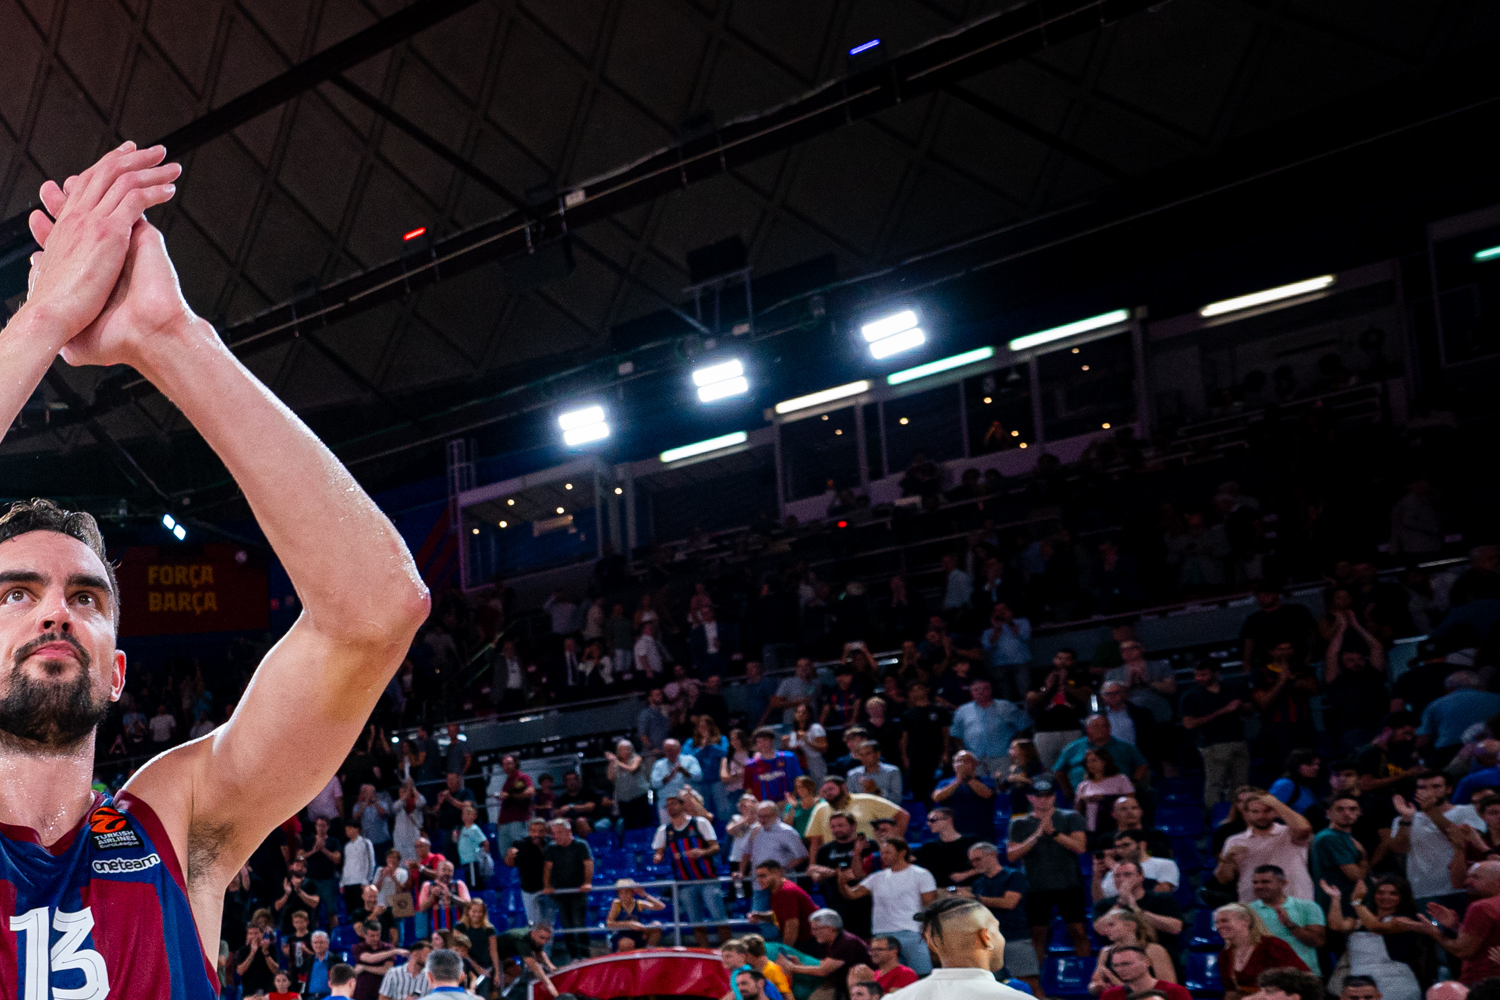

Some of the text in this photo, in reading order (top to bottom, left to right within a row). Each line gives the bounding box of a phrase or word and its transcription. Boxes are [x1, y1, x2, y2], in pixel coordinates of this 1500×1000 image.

[148, 564, 214, 589] FORÇA
[148, 591, 218, 616] BARÇA
[92, 853, 160, 874] oneteam
